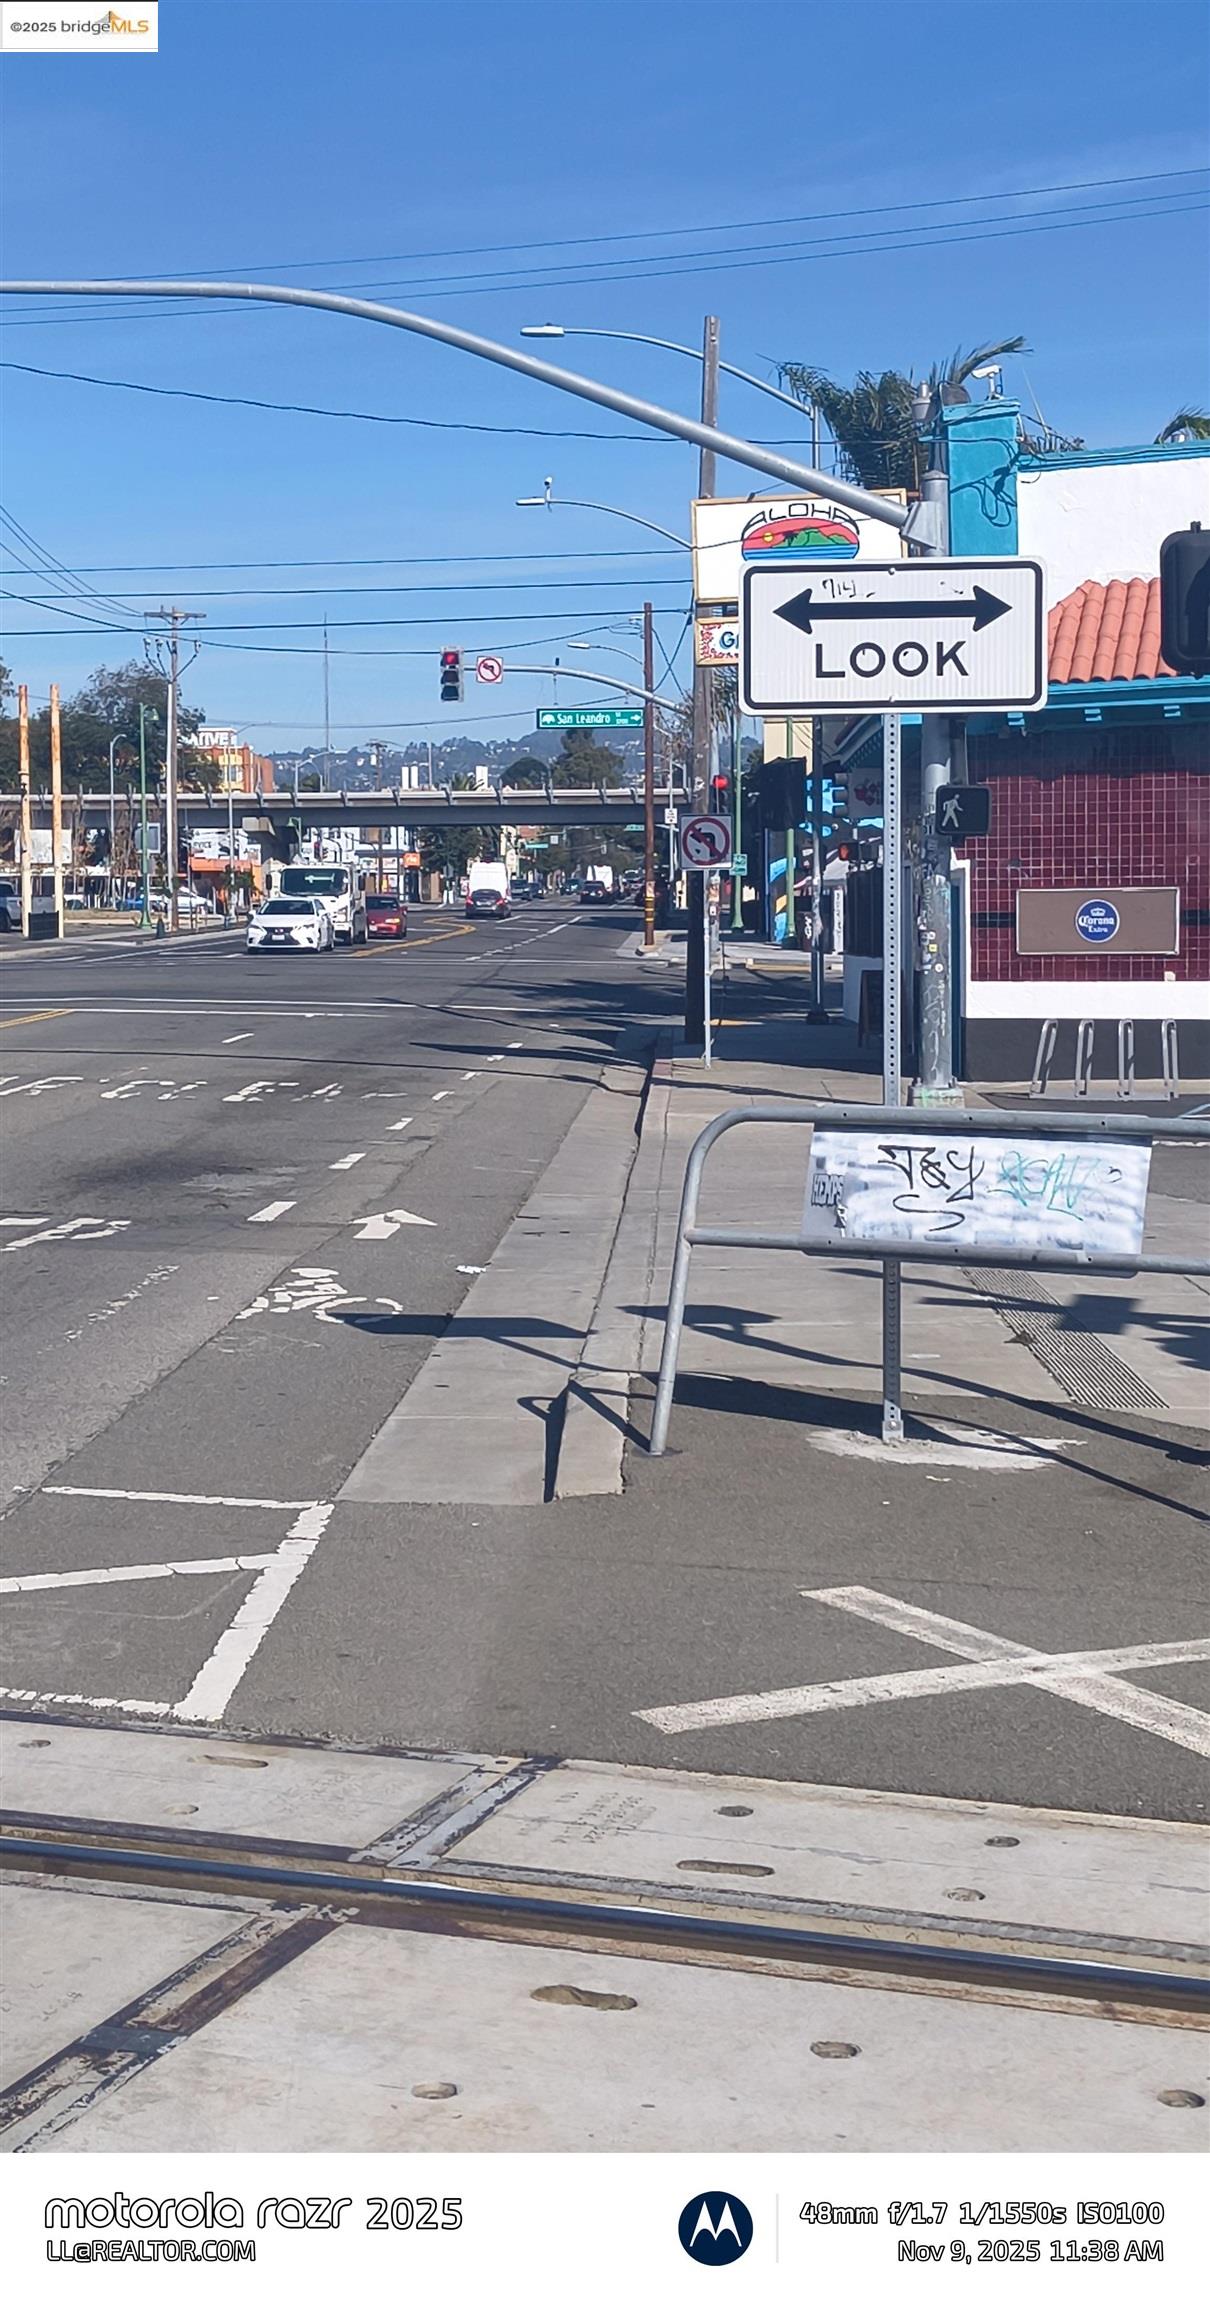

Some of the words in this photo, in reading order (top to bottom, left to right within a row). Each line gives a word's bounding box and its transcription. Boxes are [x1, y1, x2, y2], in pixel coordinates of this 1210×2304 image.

[741, 503, 861, 541] ALOHA
[815, 640, 969, 678] LOOK
[557, 713, 573, 724] San
[576, 712, 611, 724] Leandro
[1078, 915, 1115, 928] Corona
